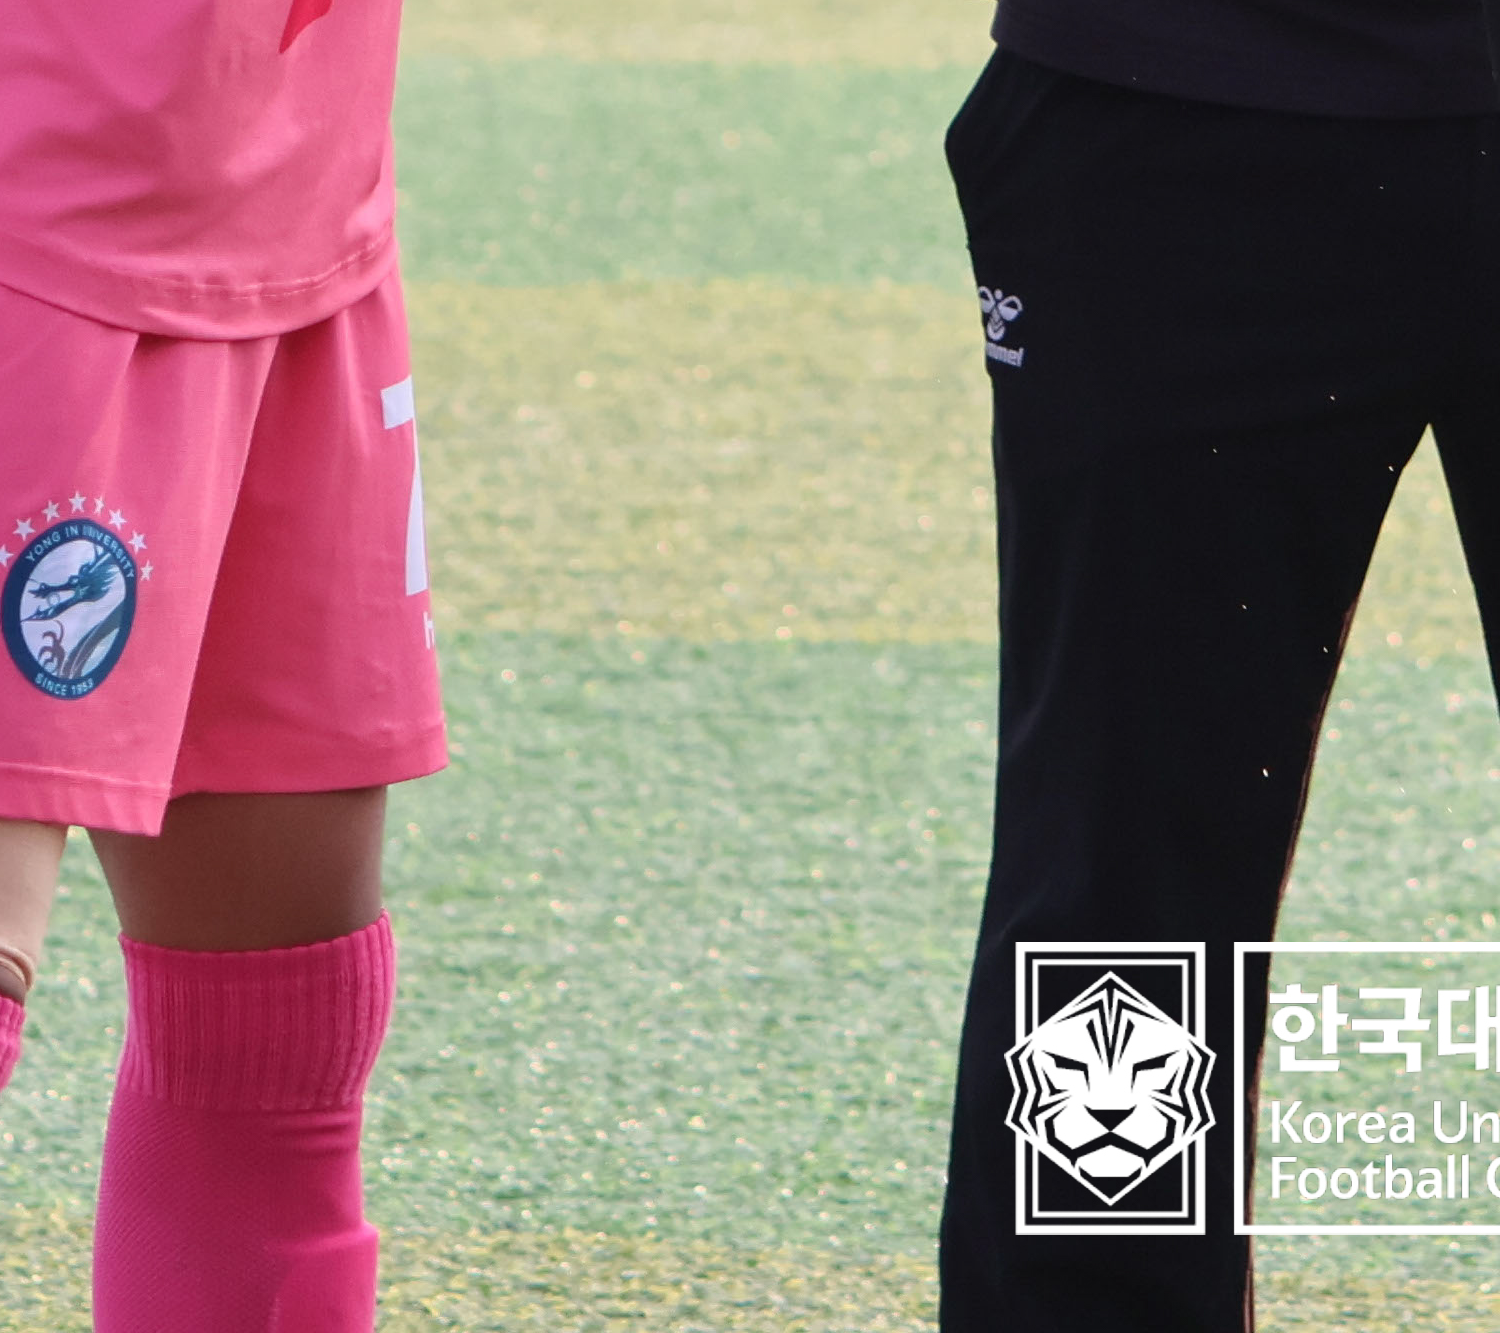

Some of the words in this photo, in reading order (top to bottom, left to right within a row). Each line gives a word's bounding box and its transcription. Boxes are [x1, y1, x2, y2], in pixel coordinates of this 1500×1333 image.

[25, 531, 62, 562] YONG
[64, 524, 80, 538] IN
[34, 672, 67, 697] SINCE
